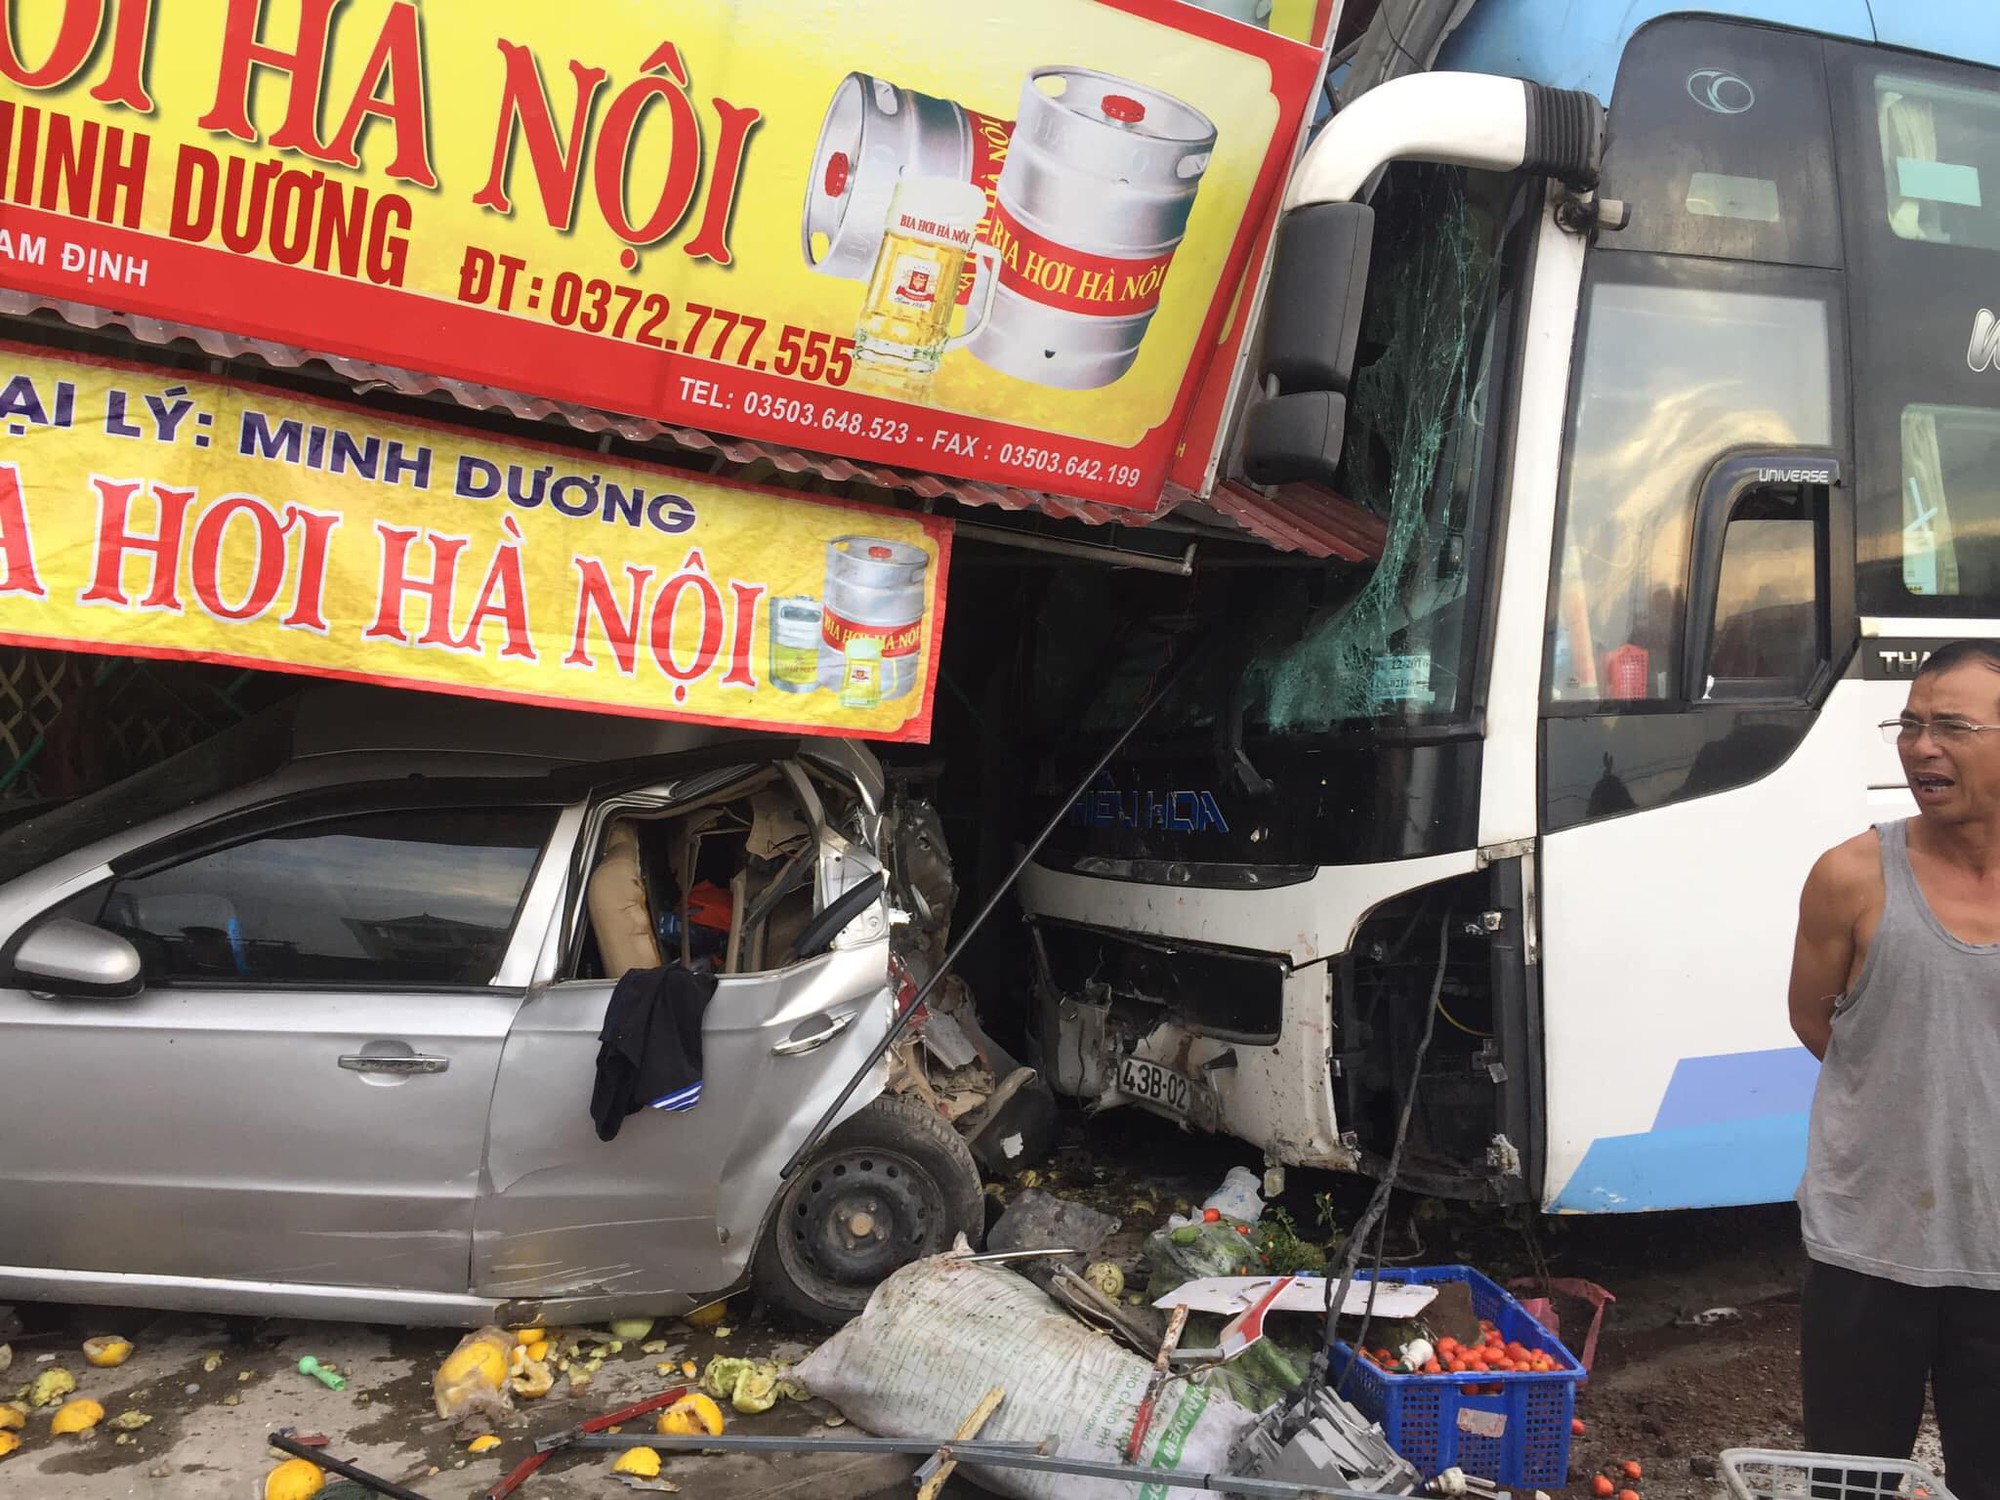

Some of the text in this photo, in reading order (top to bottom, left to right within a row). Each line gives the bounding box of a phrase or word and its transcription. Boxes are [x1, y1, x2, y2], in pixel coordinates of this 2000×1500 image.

[472, 37, 760, 270] NỘI
[61, 243, 149, 287] ĐỊNH
[169, 143, 413, 288] DƯƠNG
[550, 271, 857, 386] 0372.777.555
[900, 214, 916, 230] BIA
[990, 215, 1020, 273] BIA
[1021, 250, 1076, 295] HƠI
[1075, 266, 1117, 302] HÀ
[1119, 261, 1168, 302] NỘI
[106, 386, 213, 448] LÝ:
[240, 411, 433, 490] MINH
[455, 455, 697, 534] DƯƠNG
[679, 375, 735, 411] TEL:
[743, 390, 910, 444] 03503.648.523
[931, 428, 977, 460] FAX
[998, 447, 1141, 489] 03503.642.199
[1759, 468, 1829, 483] UNIVERSE
[81, 478, 341, 634] HƠI
[366, 515, 538, 661] HÀ
[563, 551, 765, 703] NỘI
[824, 613, 841, 641] BIA
